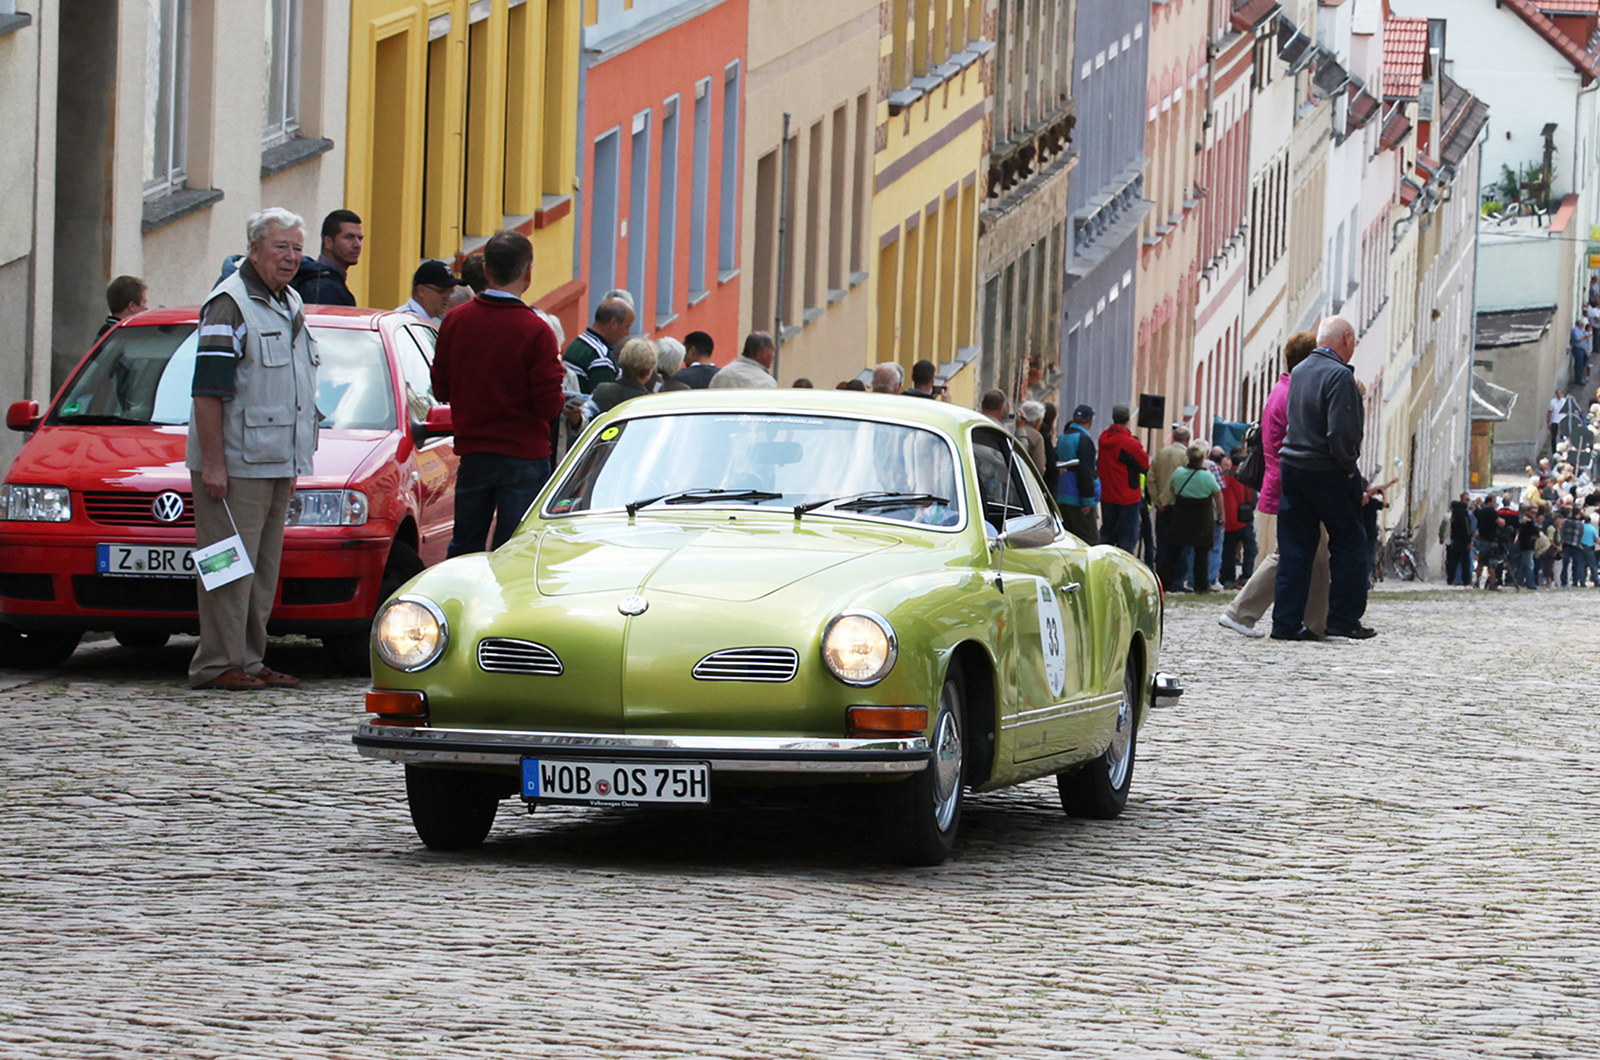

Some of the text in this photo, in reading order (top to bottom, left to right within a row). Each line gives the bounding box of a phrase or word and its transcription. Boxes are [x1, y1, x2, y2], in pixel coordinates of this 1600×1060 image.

[118, 548, 132, 570] Z
[148, 549, 176, 571] BR
[1046, 616, 1059, 656] 33
[527, 781, 535, 790] D
[541, 764, 707, 798] WOB OS 75H
